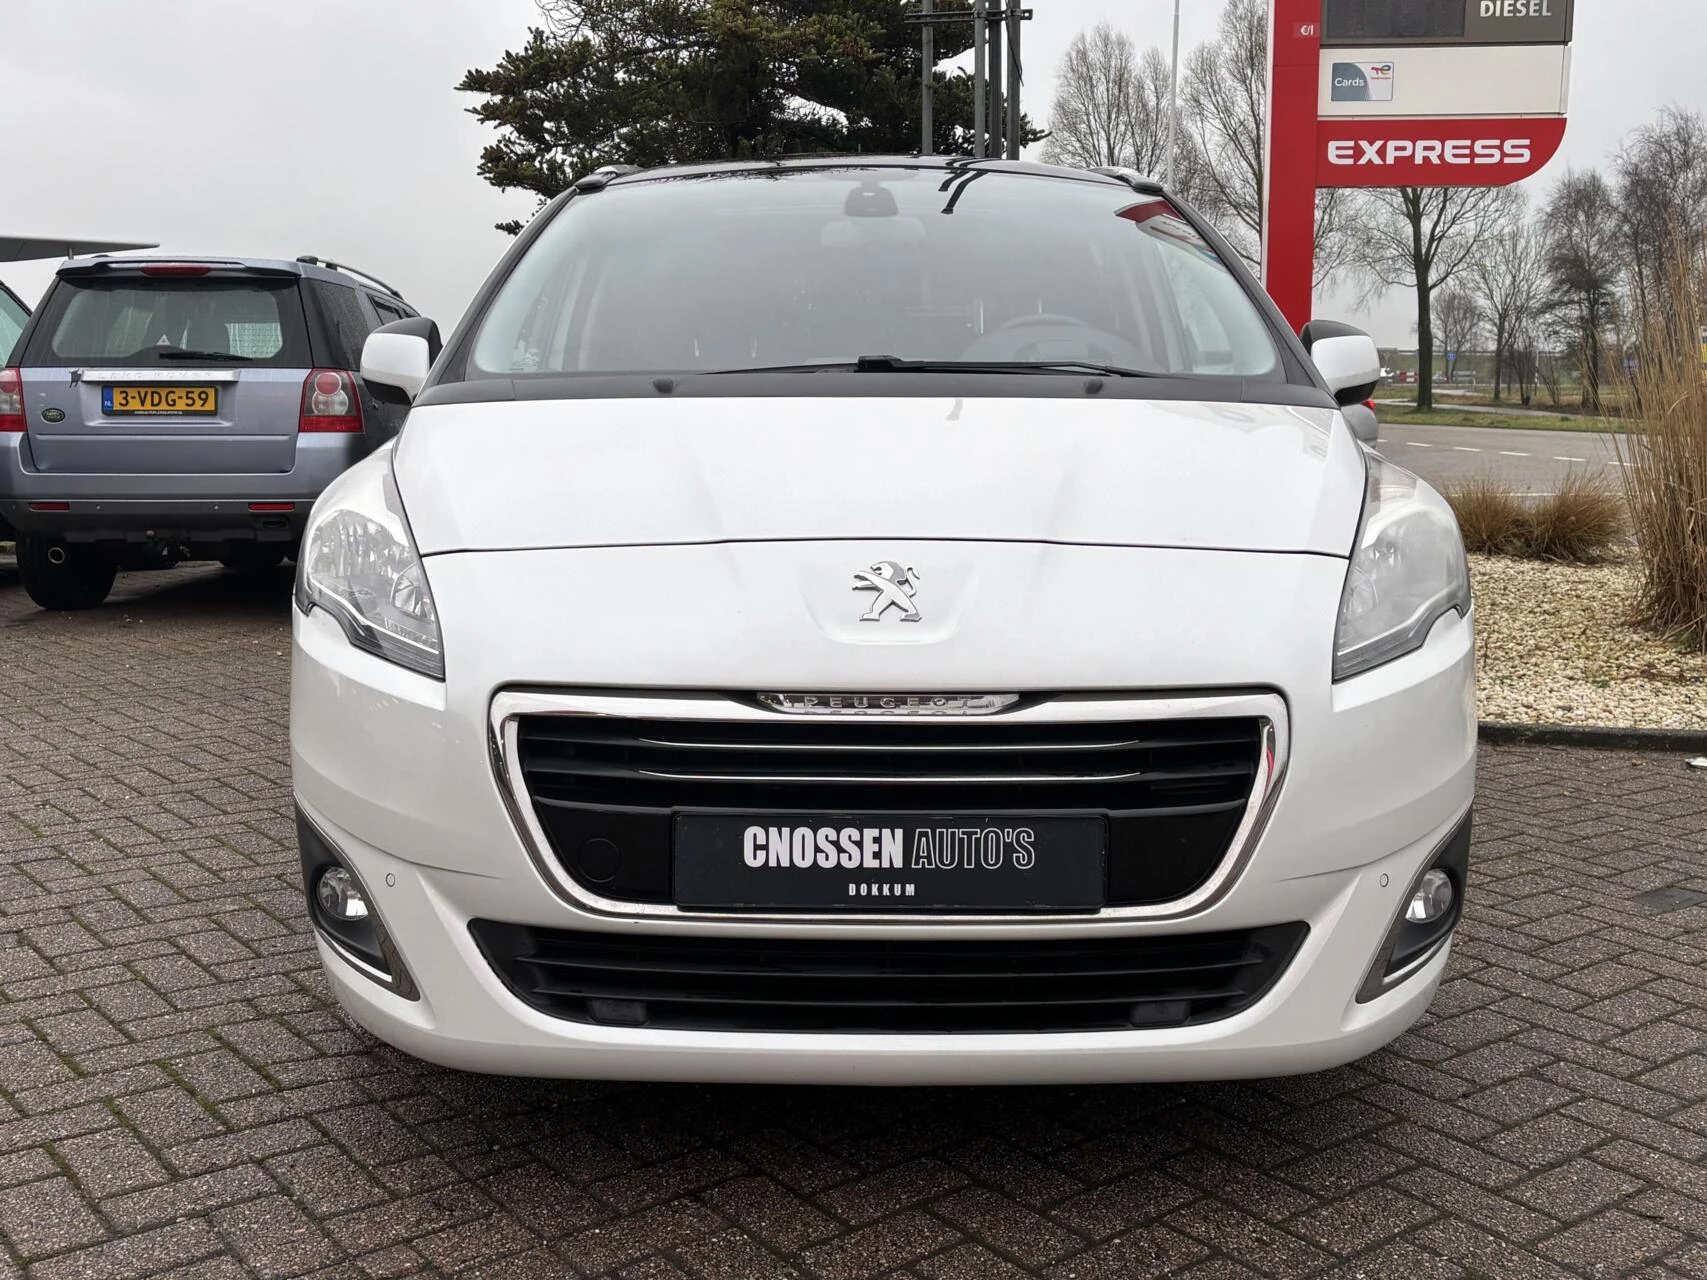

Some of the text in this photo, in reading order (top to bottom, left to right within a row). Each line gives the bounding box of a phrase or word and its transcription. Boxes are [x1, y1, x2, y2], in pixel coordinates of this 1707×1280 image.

[1480, 0, 1552, 18] DIESEL
[1334, 77, 1365, 87] Cards
[1327, 138, 1531, 165] EXPRESS
[118, 390, 209, 408] 3-VDG-59
[804, 695, 969, 709] PEUGEOT
[743, 826, 1036, 869] CNOSSEN AUTO'S
[848, 883, 916, 897] DOKKUM
